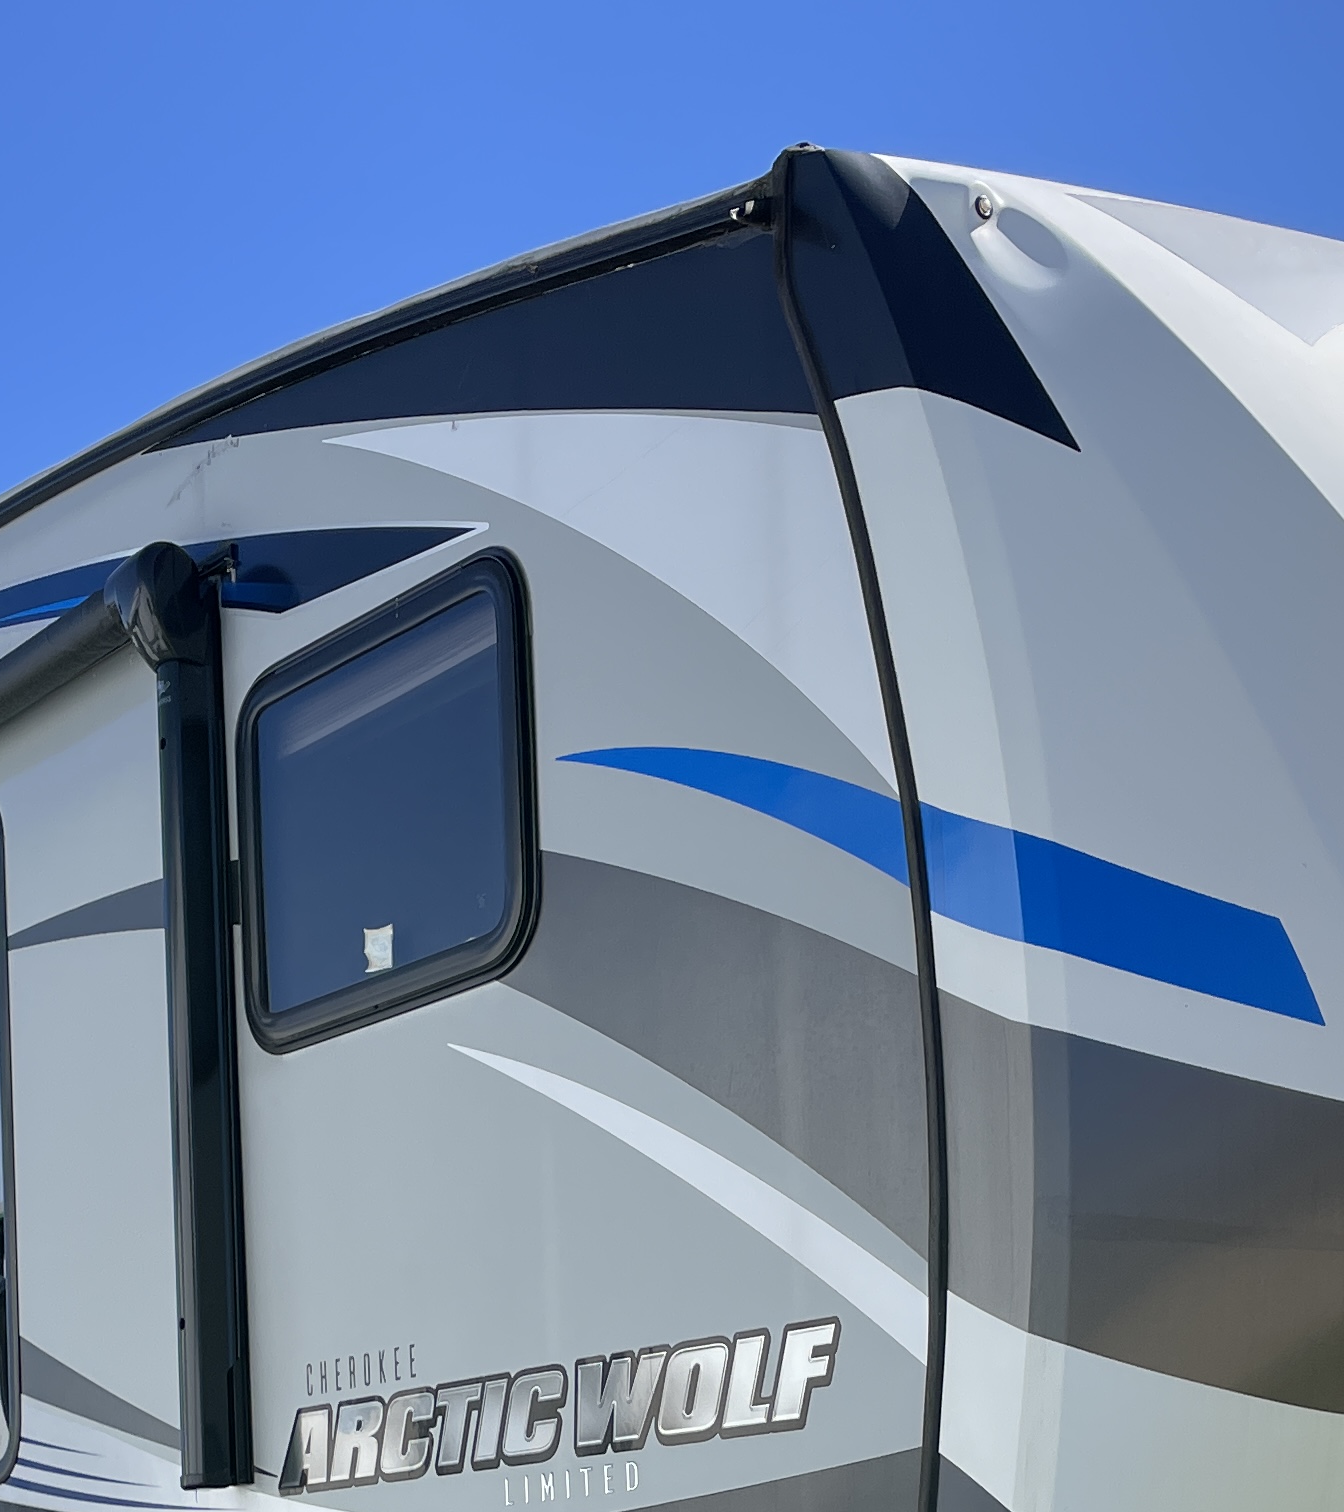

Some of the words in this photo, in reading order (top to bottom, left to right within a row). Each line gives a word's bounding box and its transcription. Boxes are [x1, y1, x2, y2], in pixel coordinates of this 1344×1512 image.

[304, 1342, 419, 1397] CHEROKEE
[278, 1363, 567, 1495] ARCTIC
[574, 1316, 842, 1457] WOLF
[504, 1460, 641, 1507] LIMITED
